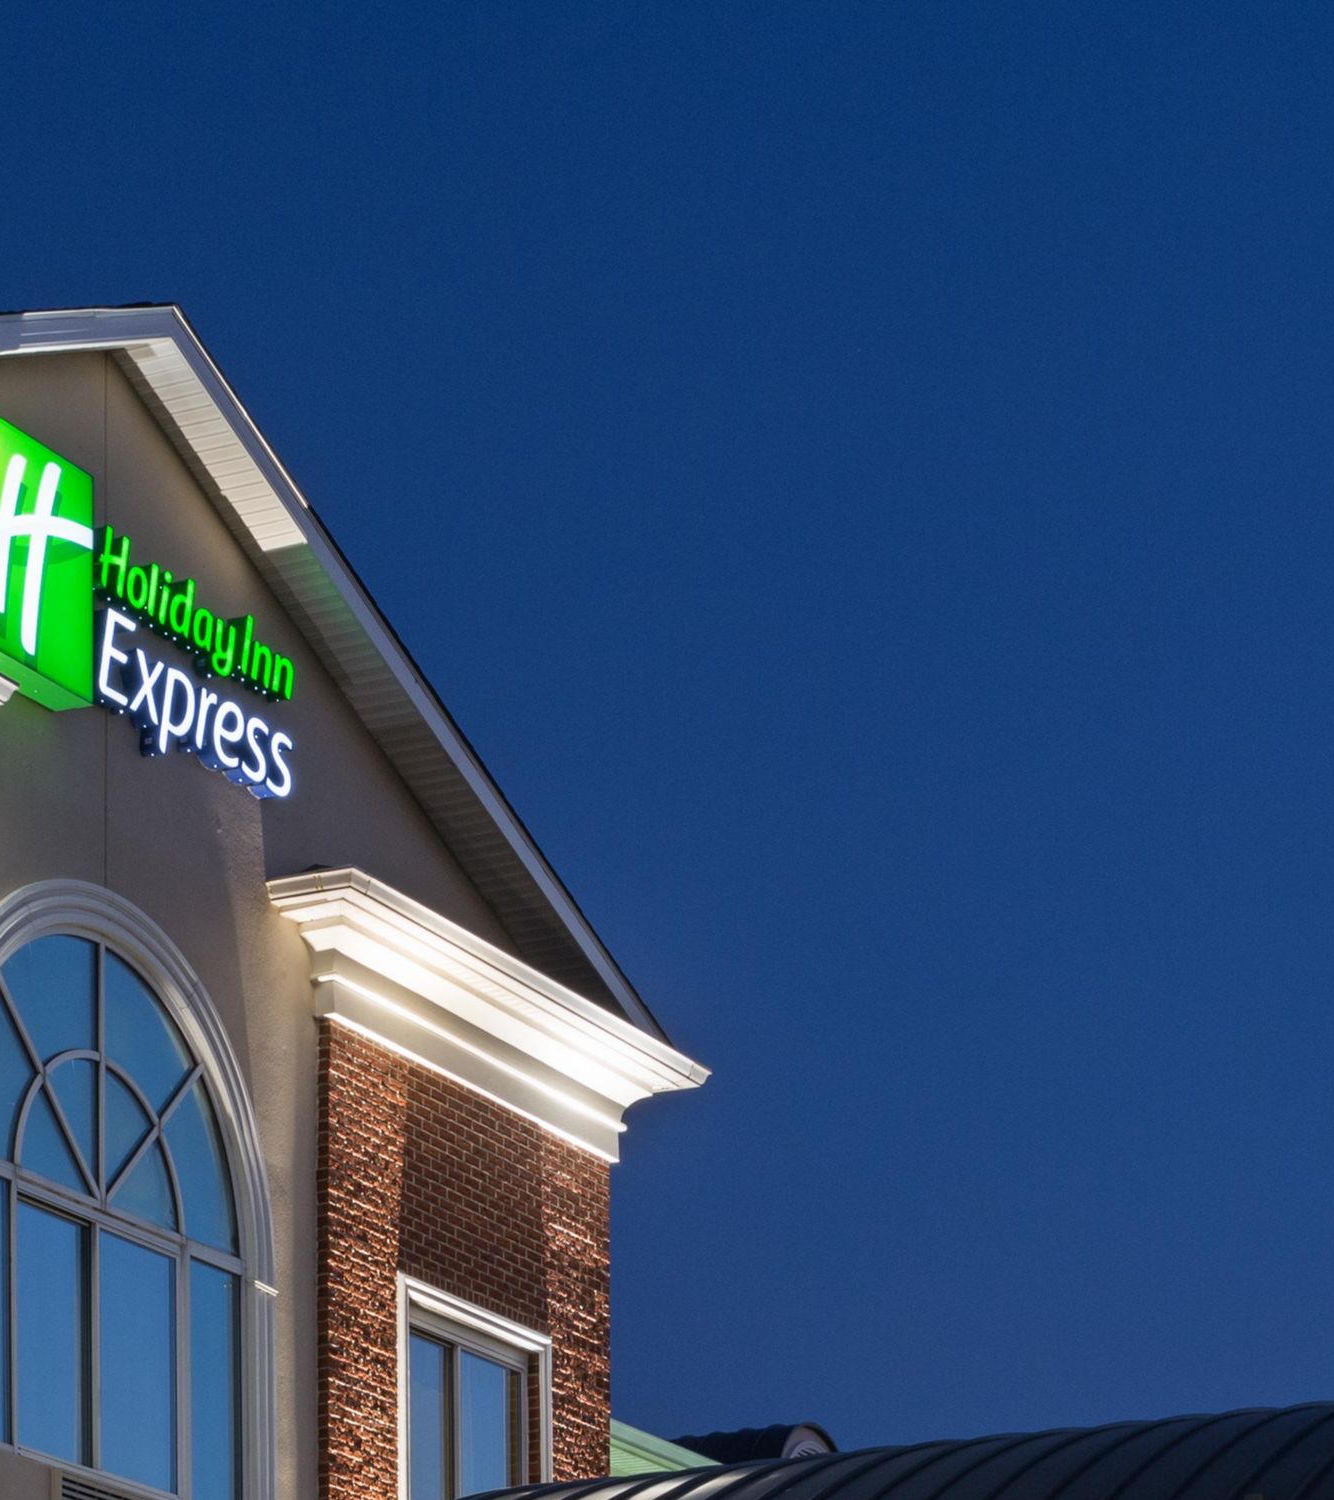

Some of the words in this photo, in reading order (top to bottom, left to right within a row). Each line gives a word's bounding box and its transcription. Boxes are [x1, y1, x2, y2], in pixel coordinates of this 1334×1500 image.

[98, 607, 293, 798] Express
[99, 525, 236, 678] Holiday
[240, 613, 296, 701] Inn
